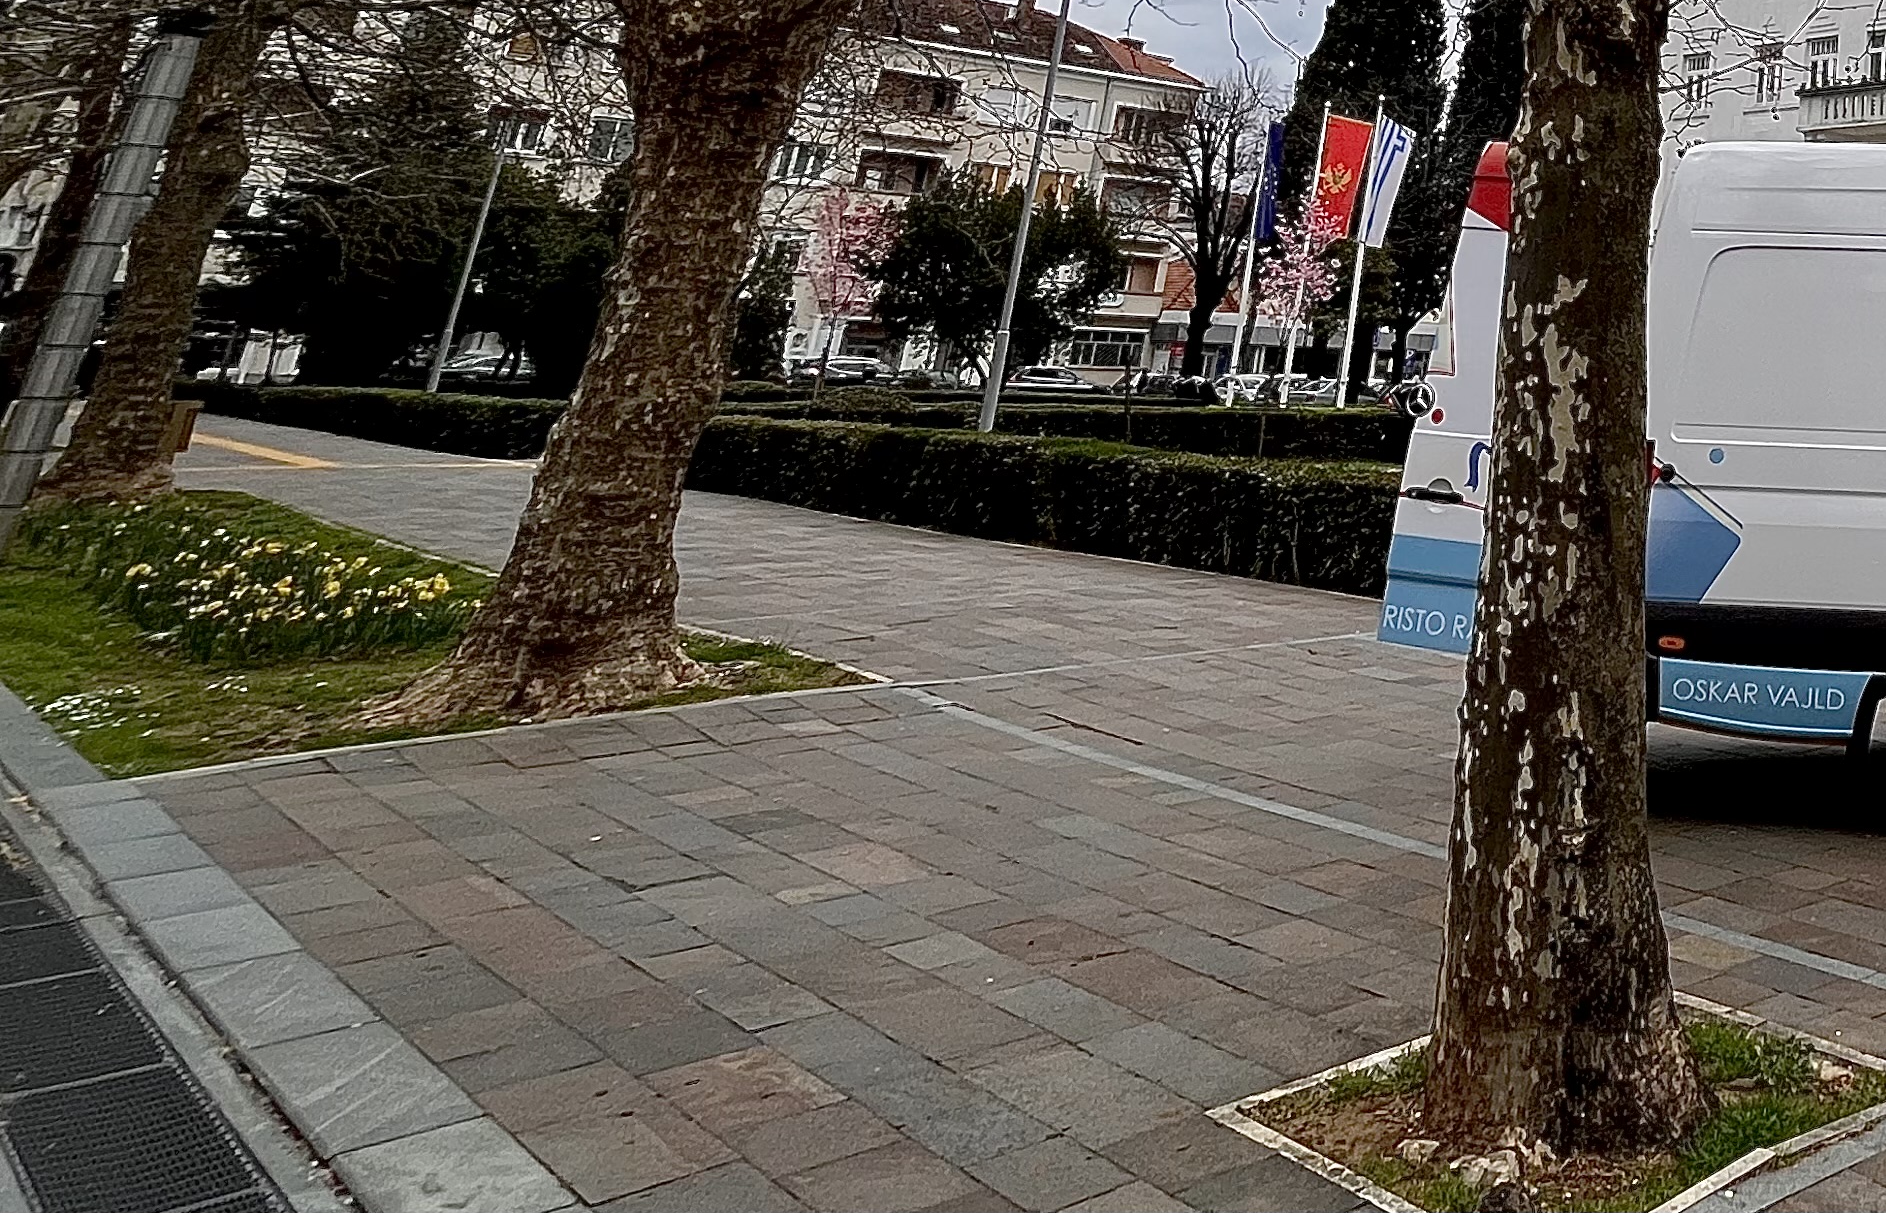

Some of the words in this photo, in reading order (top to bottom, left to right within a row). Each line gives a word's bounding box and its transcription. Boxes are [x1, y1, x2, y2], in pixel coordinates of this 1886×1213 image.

[1383, 605, 1446, 636] RISTO
[1672, 676, 1758, 705] OSKAR
[1766, 684, 1845, 711] VAJLD
